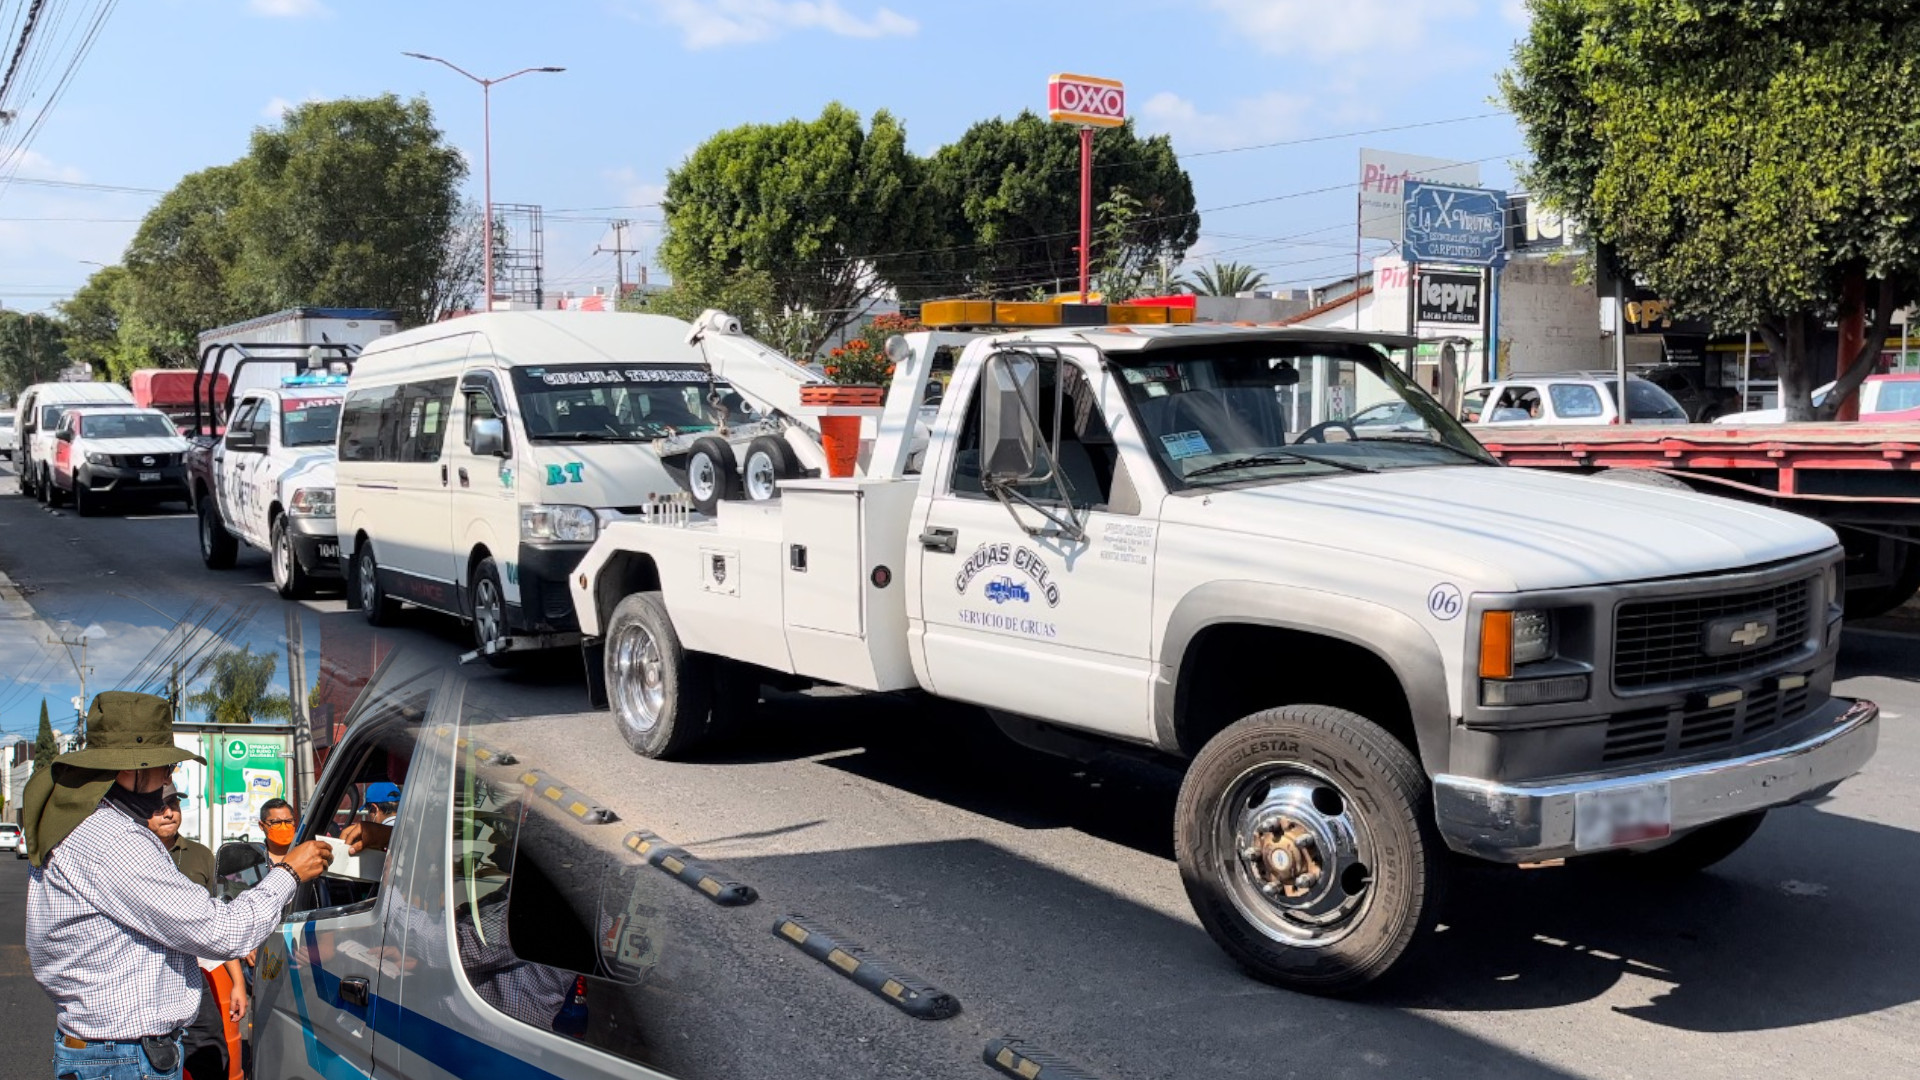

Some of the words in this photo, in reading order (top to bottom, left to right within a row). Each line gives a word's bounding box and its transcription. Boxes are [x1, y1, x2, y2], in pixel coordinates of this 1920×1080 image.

[1060, 84, 1122, 115] OXXO
[1428, 243, 1481, 257] CARPINTERO
[1422, 310, 1441, 320] Lacas
[545, 461, 584, 486] RT
[1013, 545, 1060, 608] CIELO
[1432, 590, 1459, 614] 06
[959, 609, 1003, 629] SERVICIO
[1005, 616, 1018, 631] DE
[1020, 619, 1056, 637] GRUAS
